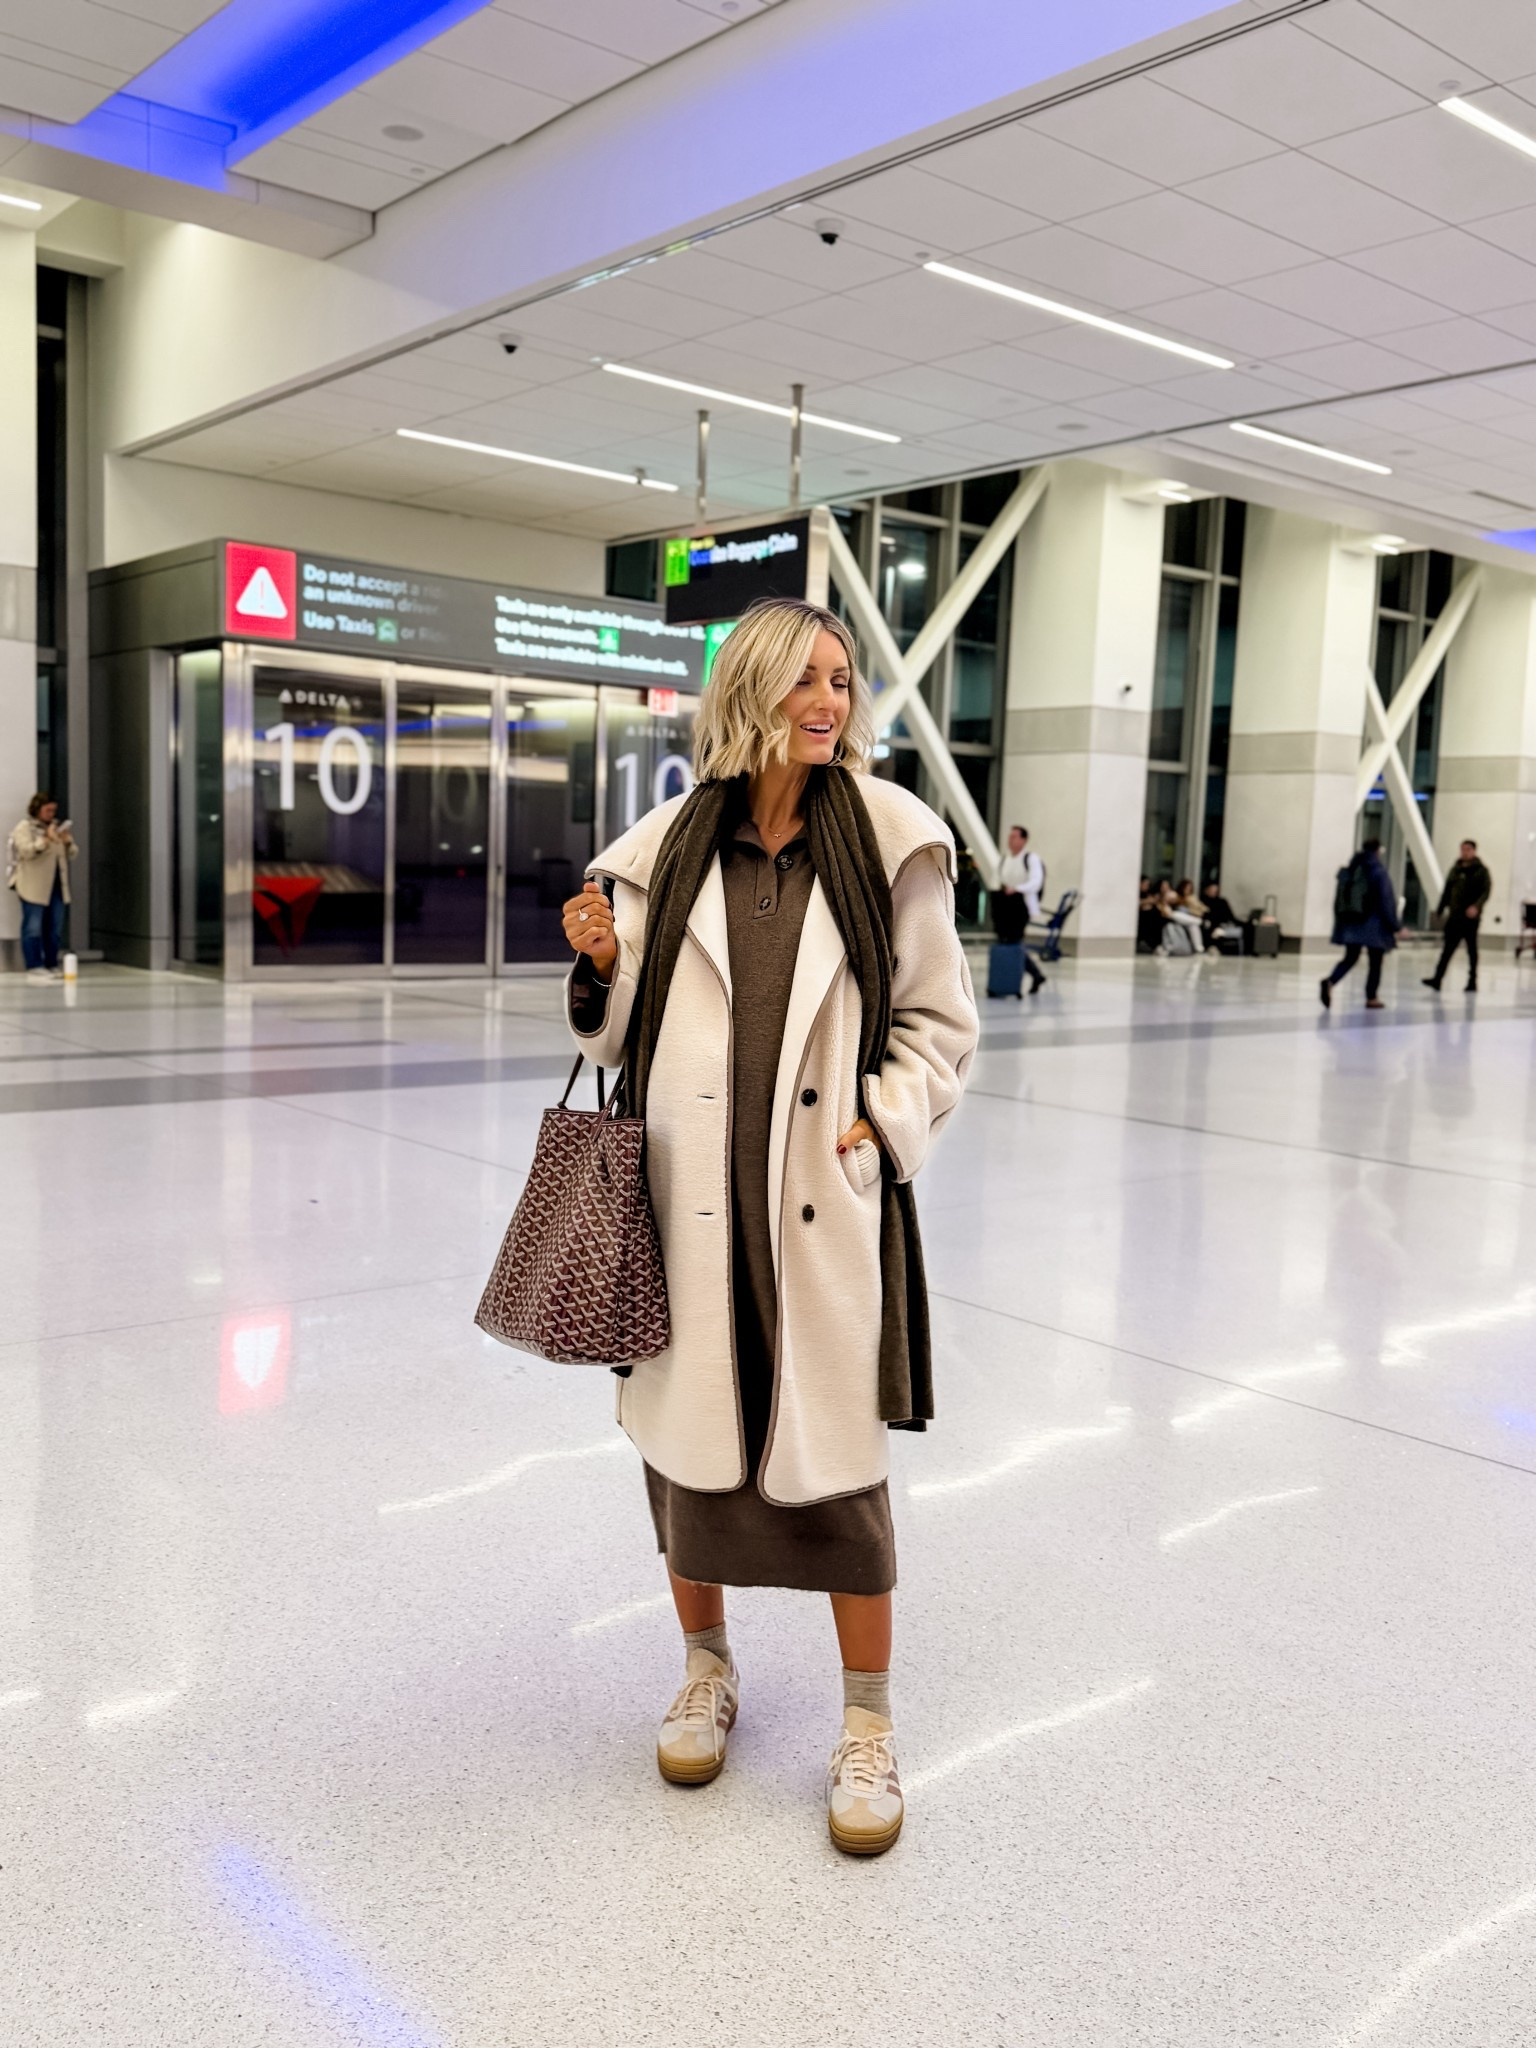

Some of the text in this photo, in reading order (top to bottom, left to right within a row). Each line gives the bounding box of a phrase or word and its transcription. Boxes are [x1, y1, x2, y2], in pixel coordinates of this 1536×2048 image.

[303, 563, 327, 584] Do
[329, 570, 355, 587] not
[357, 575, 408, 596] accept
[303, 586, 325, 602] an
[326, 588, 395, 611] unknown
[303, 609, 336, 631] Use
[336, 614, 376, 636] Taxis
[294, 689, 351, 710] DELTA
[265, 722, 373, 815] 10
